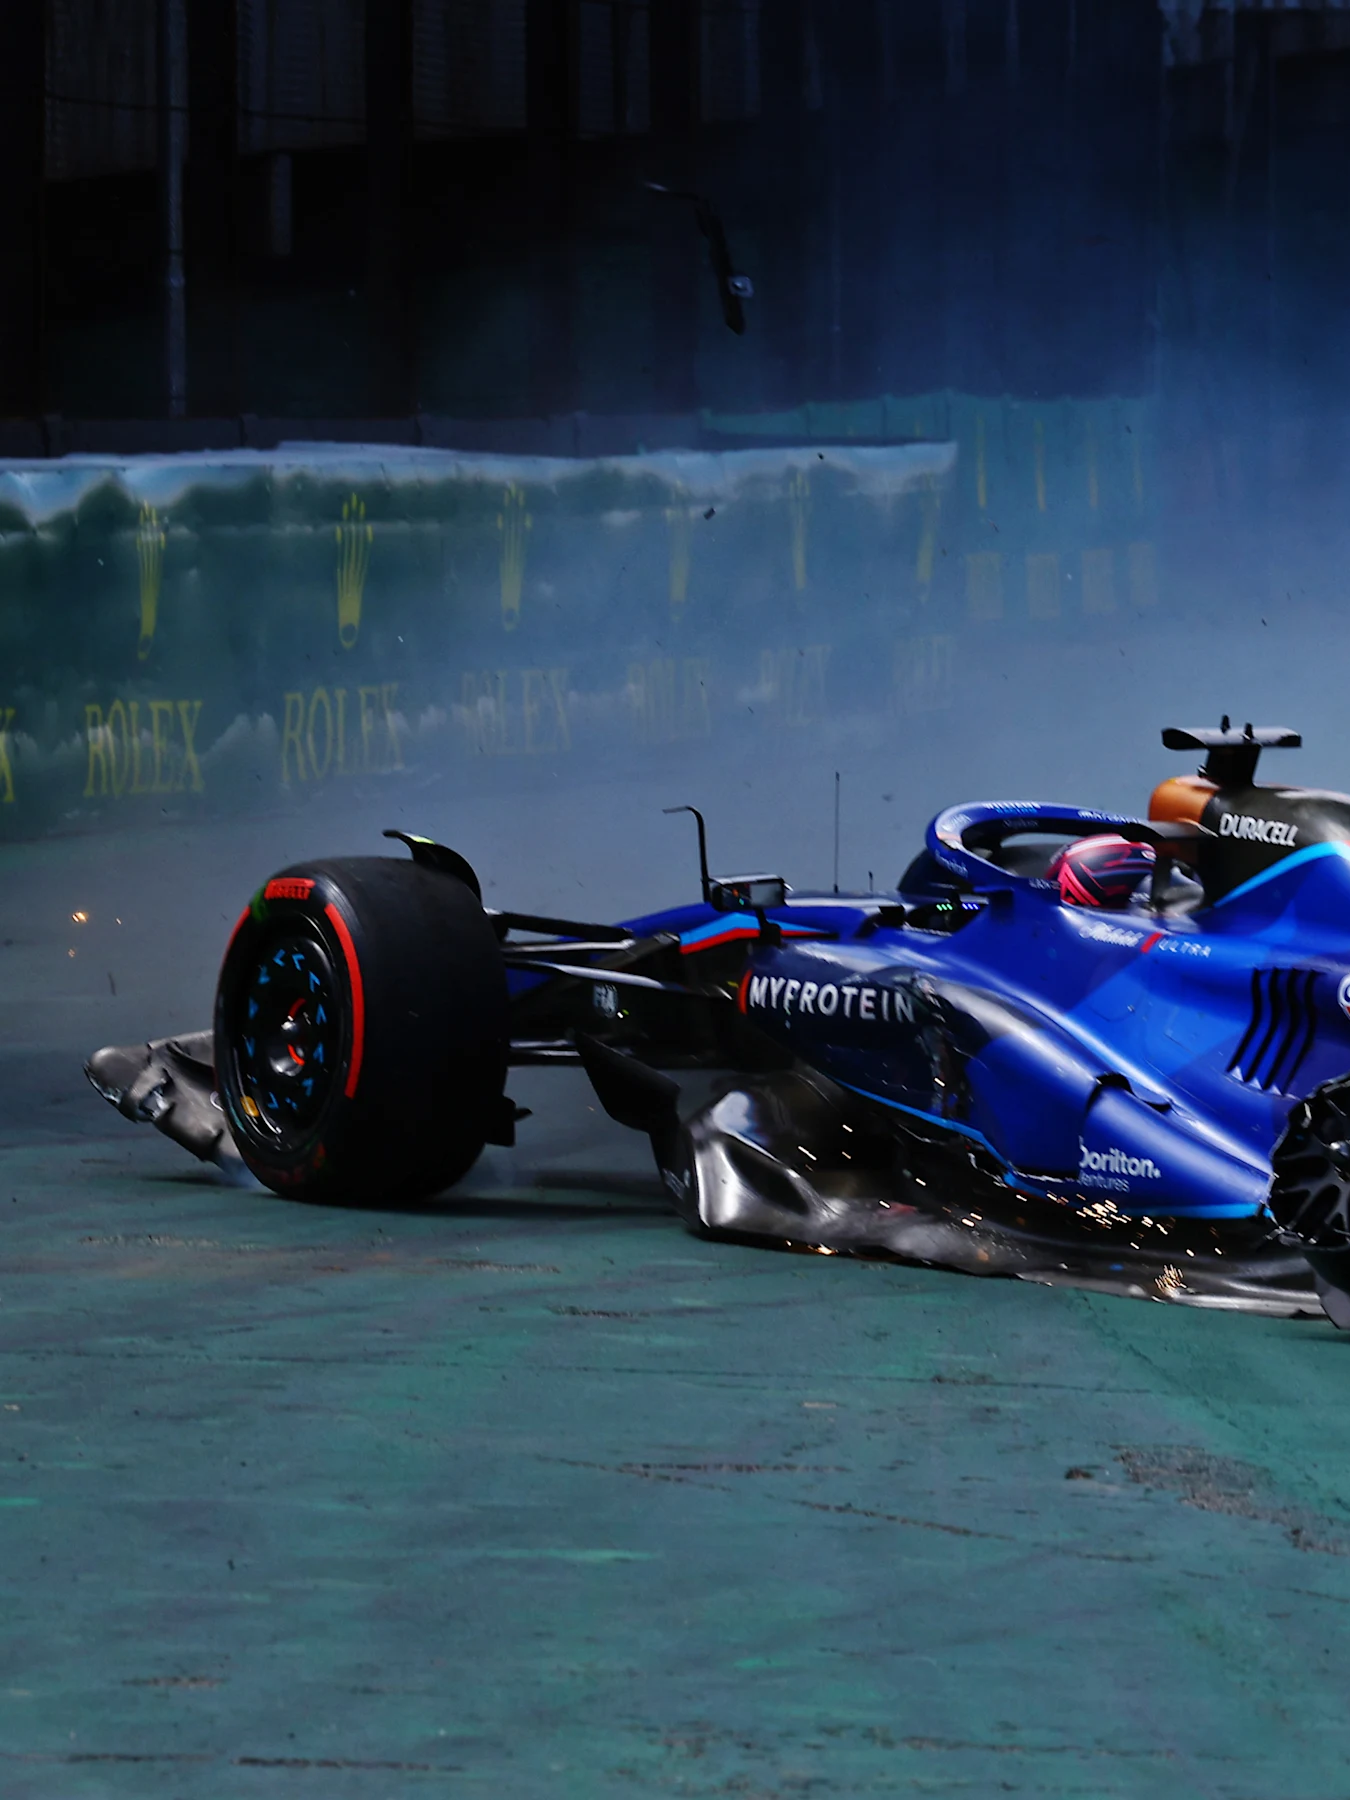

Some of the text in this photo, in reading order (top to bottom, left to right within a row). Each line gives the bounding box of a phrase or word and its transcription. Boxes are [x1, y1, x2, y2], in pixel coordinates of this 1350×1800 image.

[83, 699, 204, 797] ROLEX
[1219, 812, 1299, 848] DURACELL
[749, 975, 917, 1025] MYPROTEIN
